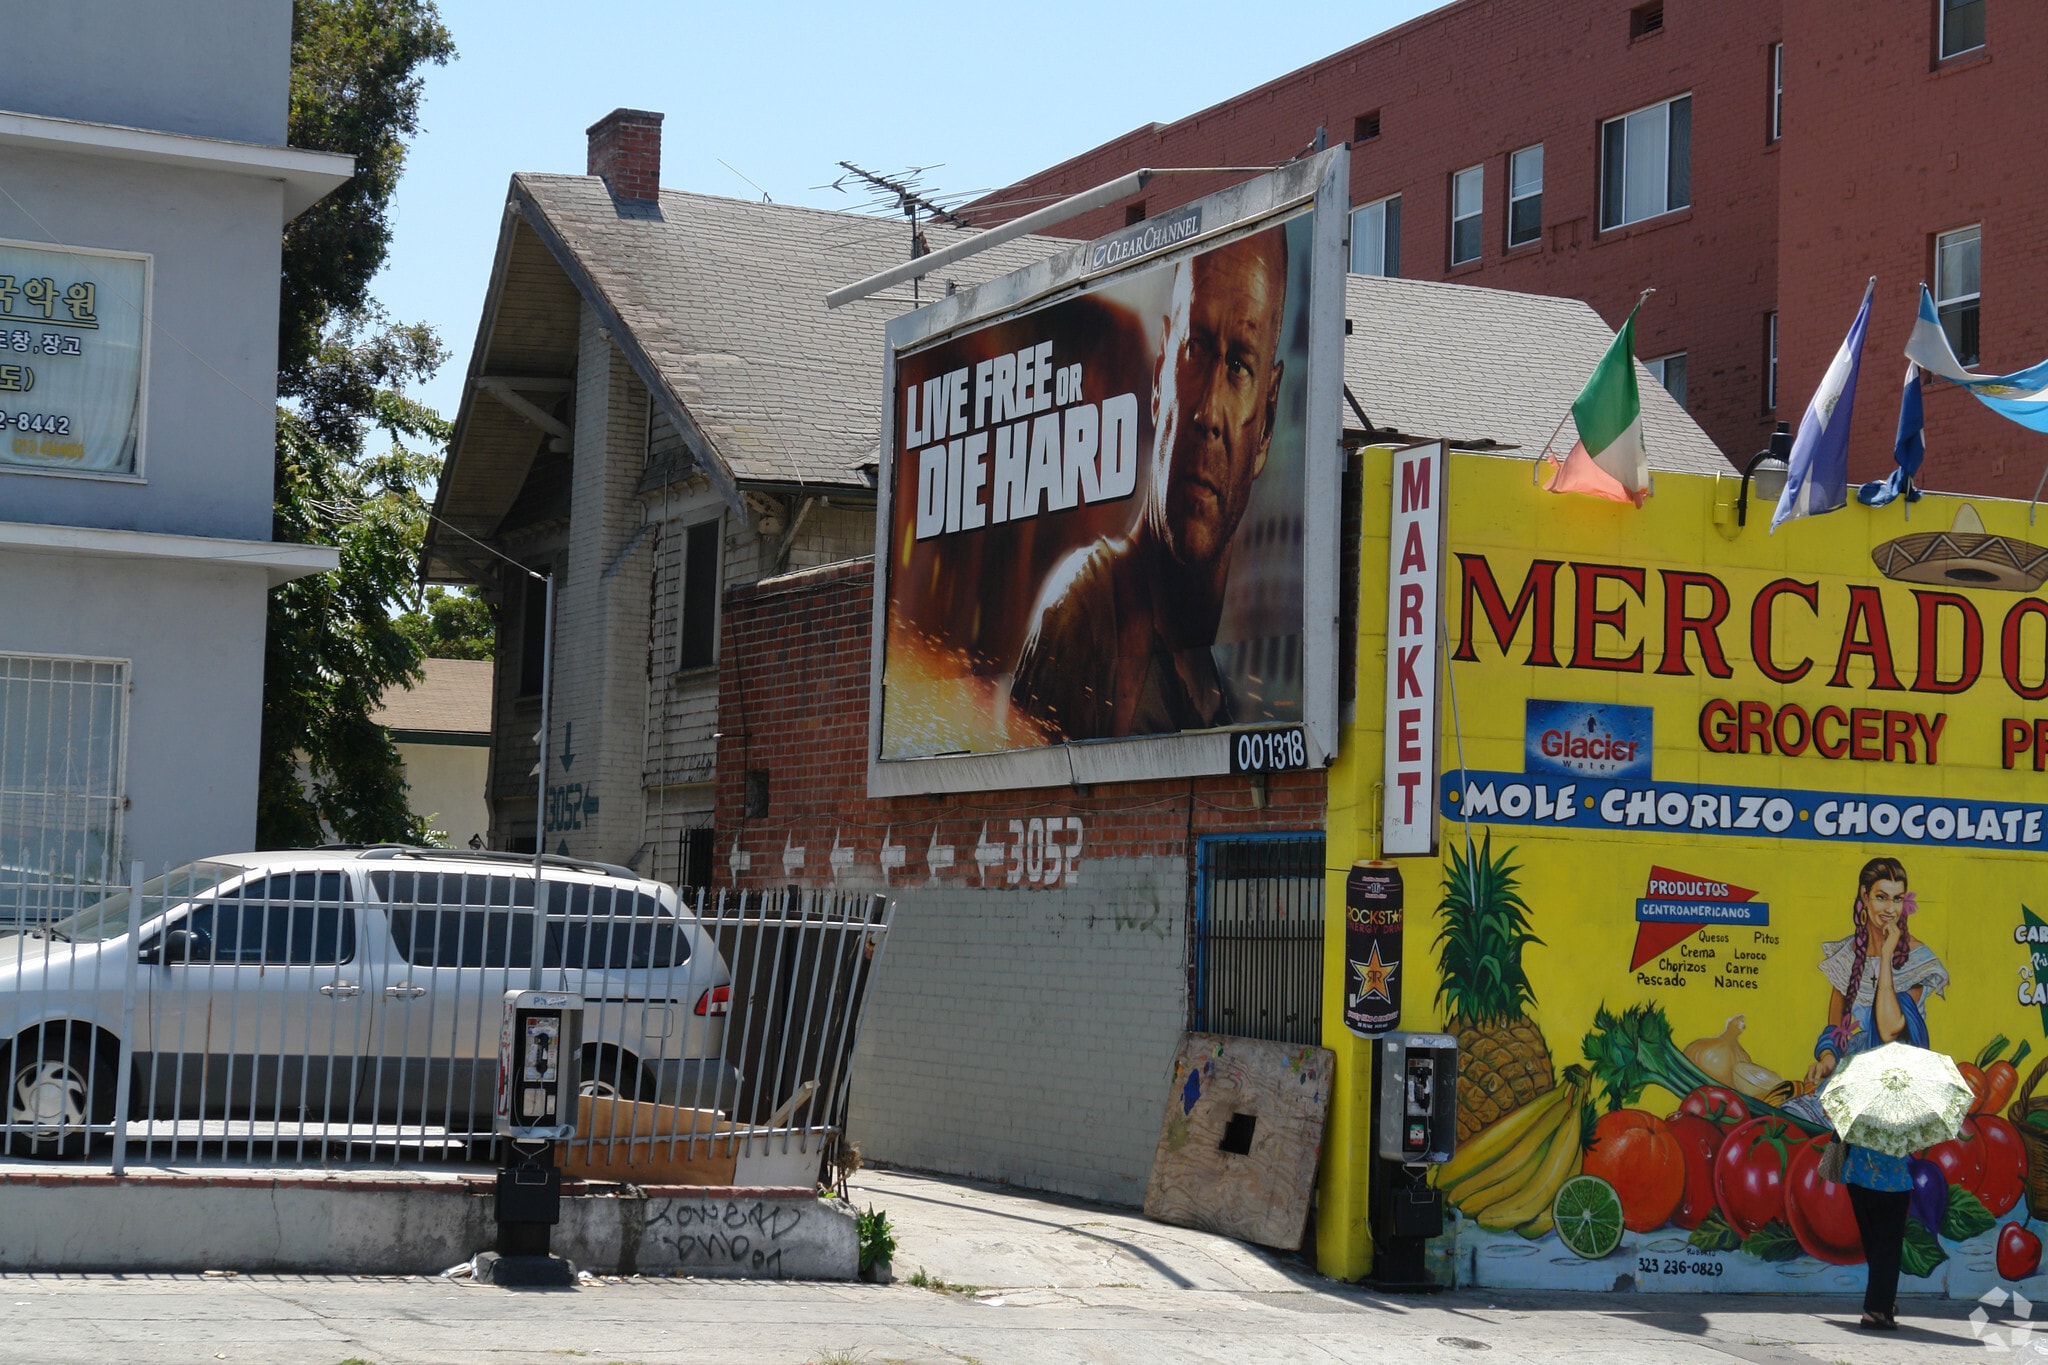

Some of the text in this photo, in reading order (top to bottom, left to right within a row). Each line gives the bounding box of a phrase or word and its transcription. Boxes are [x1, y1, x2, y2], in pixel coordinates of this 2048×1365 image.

[906, 340, 1083, 450] LIVE FREE OR
[916, 392, 1138, 541] DIE HARD
[1453, 551, 2048, 701] MERCADO
[1397, 456, 1432, 826] MARKET
[1700, 698, 1948, 765] GROCERY
[1238, 729, 1305, 771] 001318
[1541, 729, 1639, 762] Glacier
[1562, 759, 1616, 771] Water
[1460, 781, 2043, 845] MOLE CHORIZO CHOCOLATE
[1649, 879, 1730, 897] PRODUCTOS
[1642, 904, 1750, 919] CENTROAMERICANOS
[1698, 930, 1779, 945] Quesos Pitos
[1681, 944, 1767, 961] Crema Loroco
[1659, 958, 1759, 975] Chorizos Carne
[1637, 972, 1758, 990] Pescado Nances
[1638, 1258, 1723, 1277] 323 236-0829
